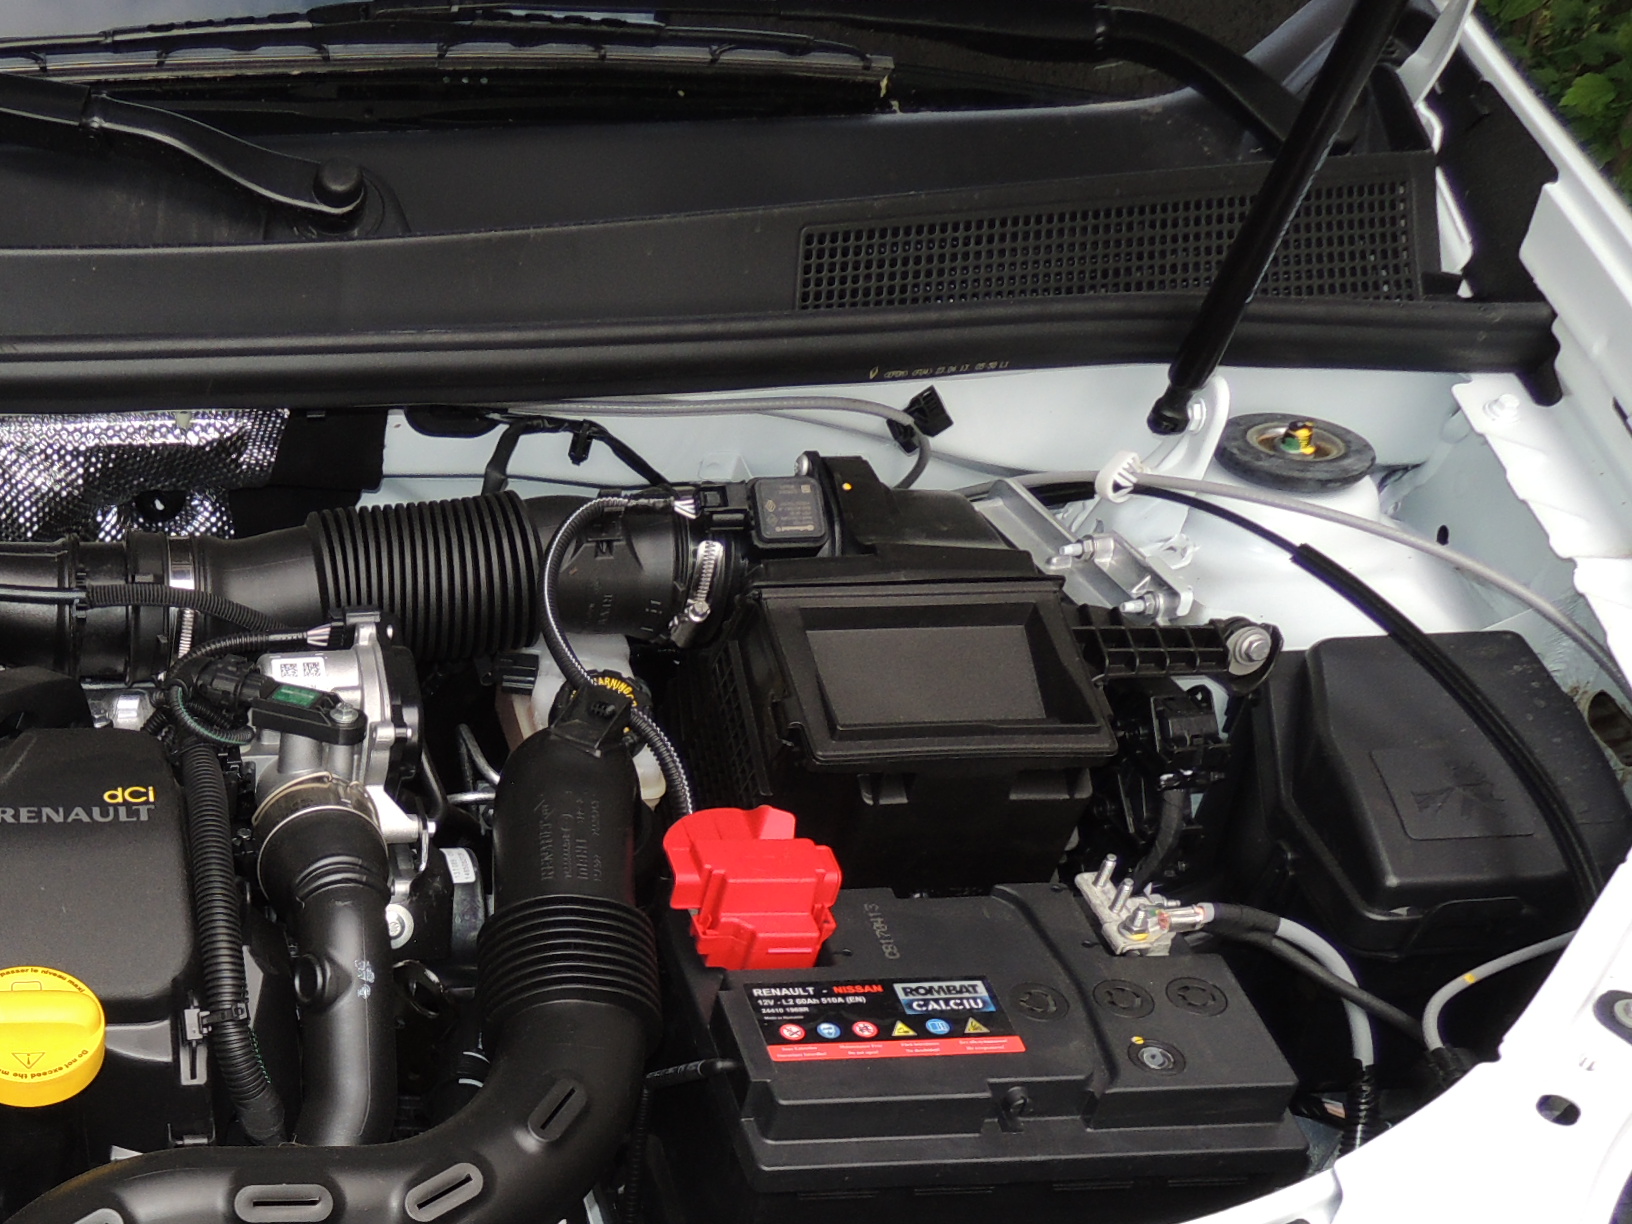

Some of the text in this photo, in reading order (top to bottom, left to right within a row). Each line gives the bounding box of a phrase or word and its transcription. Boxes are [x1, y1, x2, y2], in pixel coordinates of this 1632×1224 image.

[103, 786, 155, 803] dCi
[40, 969, 67, 981] niveau
[67, 978, 85, 993] maxi
[752, 987, 814, 997] RENAULT
[832, 985, 884, 994] NISSAN
[901, 984, 980, 997] ROMBAT
[821, 996, 844, 1004] 510A
[846, 996, 866, 1004] (EN)
[912, 998, 983, 1011] CALCIU
[12, 1072, 28, 1080] the
[30, 1065, 64, 1079] exceed
